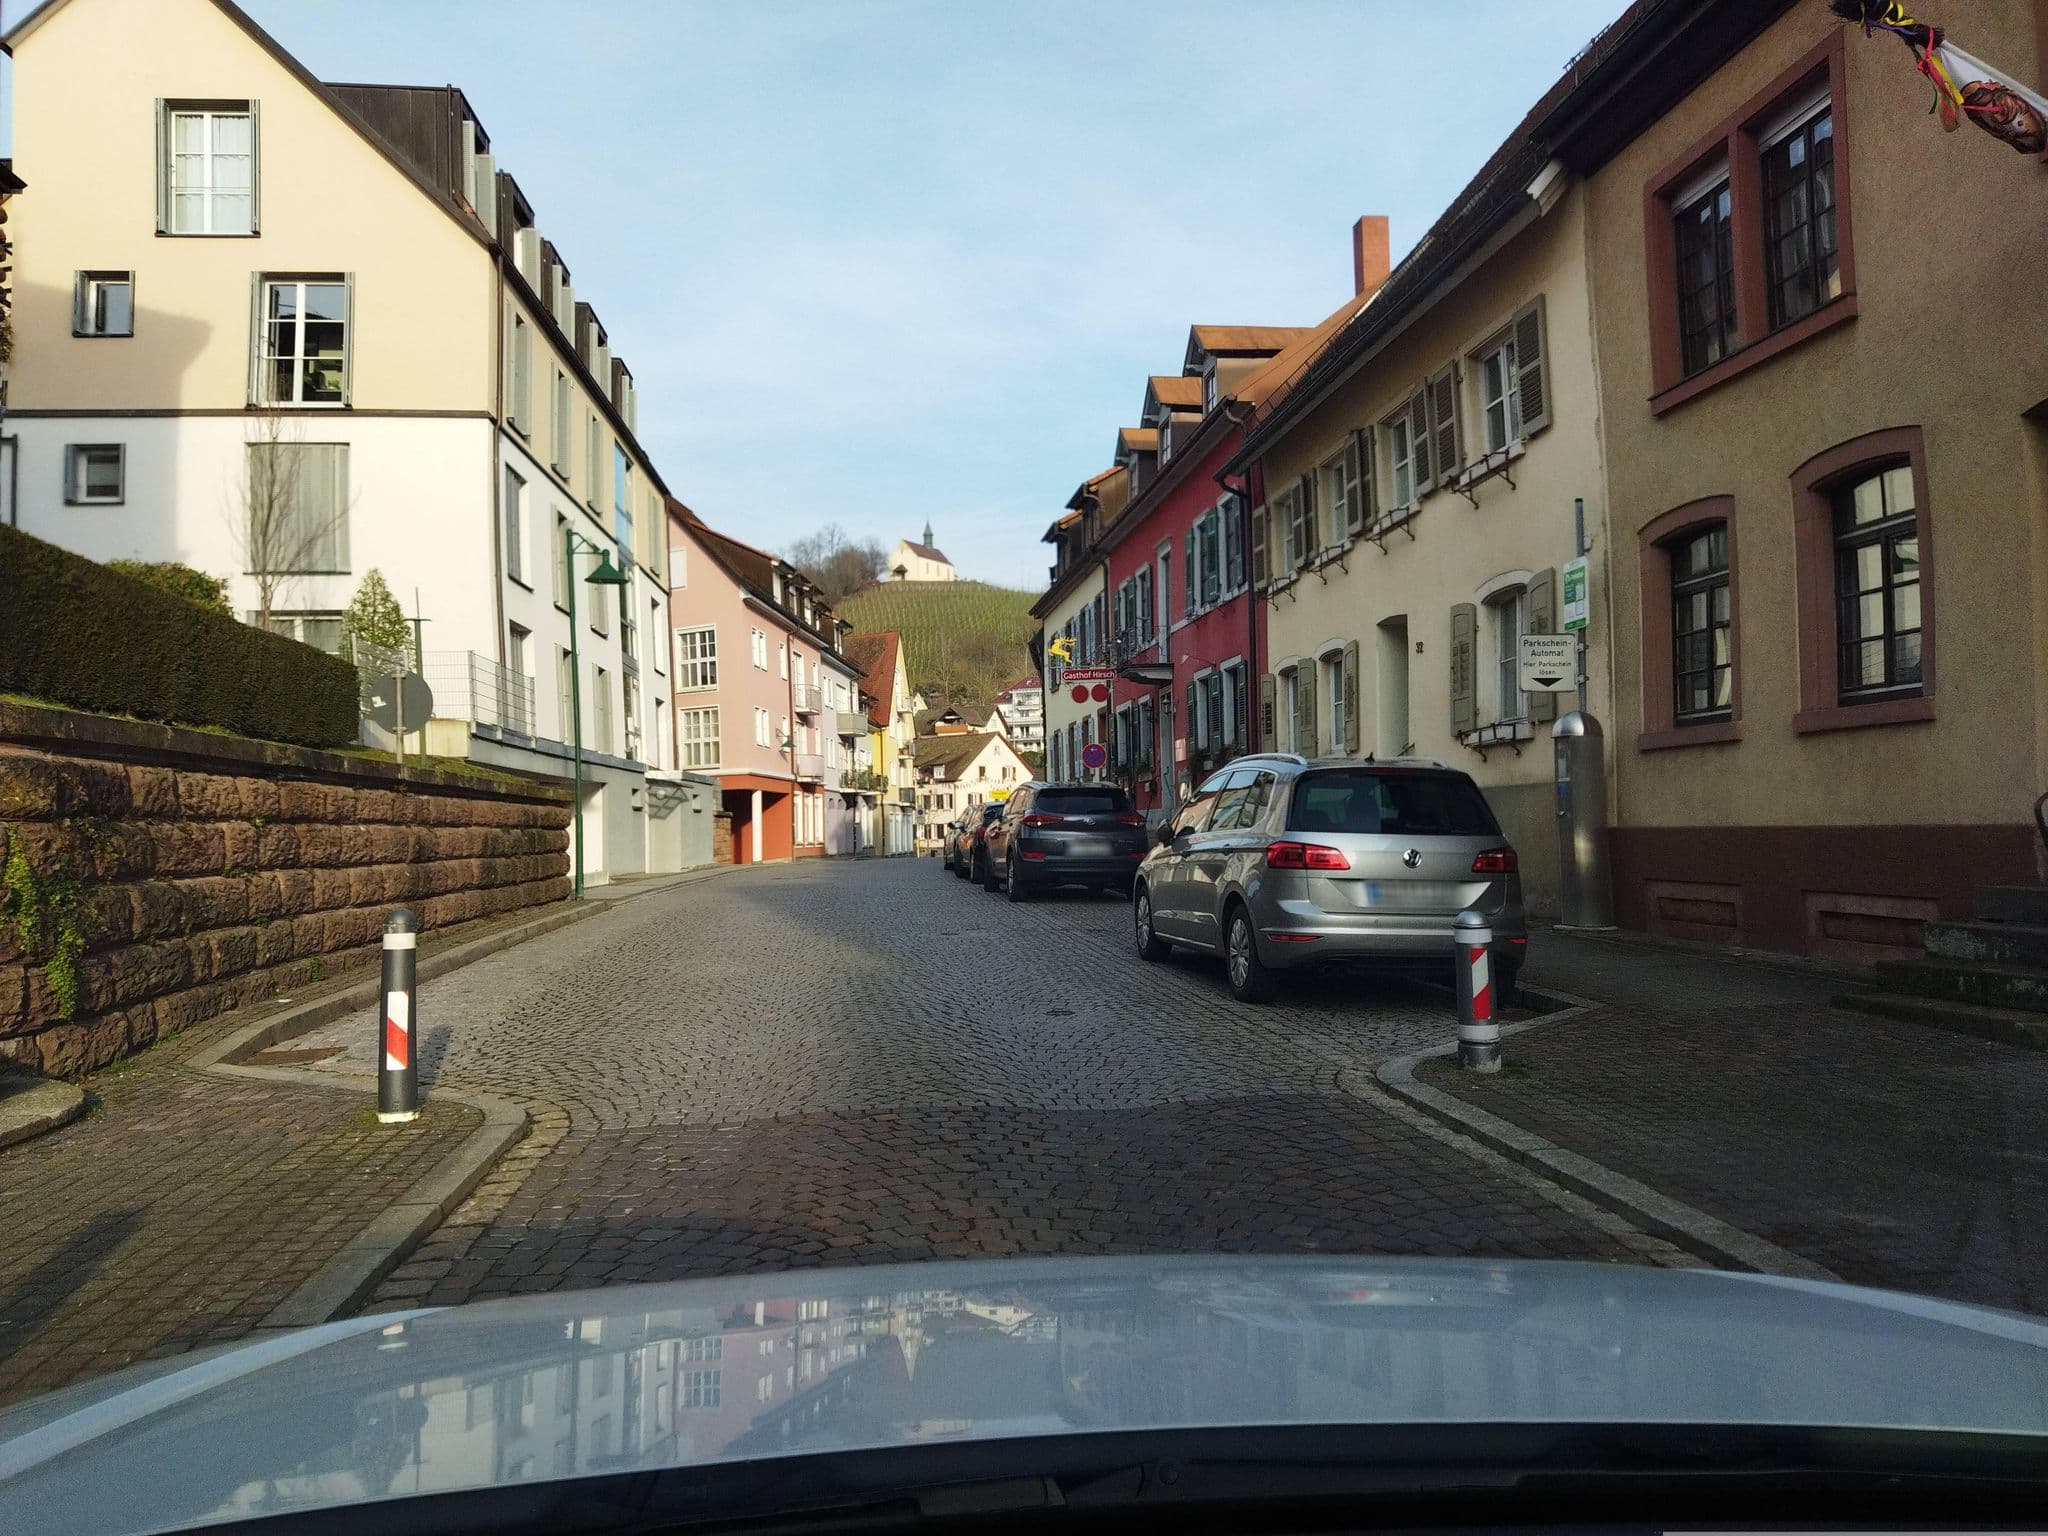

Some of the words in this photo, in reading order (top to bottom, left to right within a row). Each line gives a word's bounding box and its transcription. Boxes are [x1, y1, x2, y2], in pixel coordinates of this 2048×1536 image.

[1523, 639, 1572, 647] Parkschein-
[1530, 649, 1564, 657] Automat
[1063, 670, 1091, 680] Gasthof
[1092, 670, 1115, 679] Hirsch
